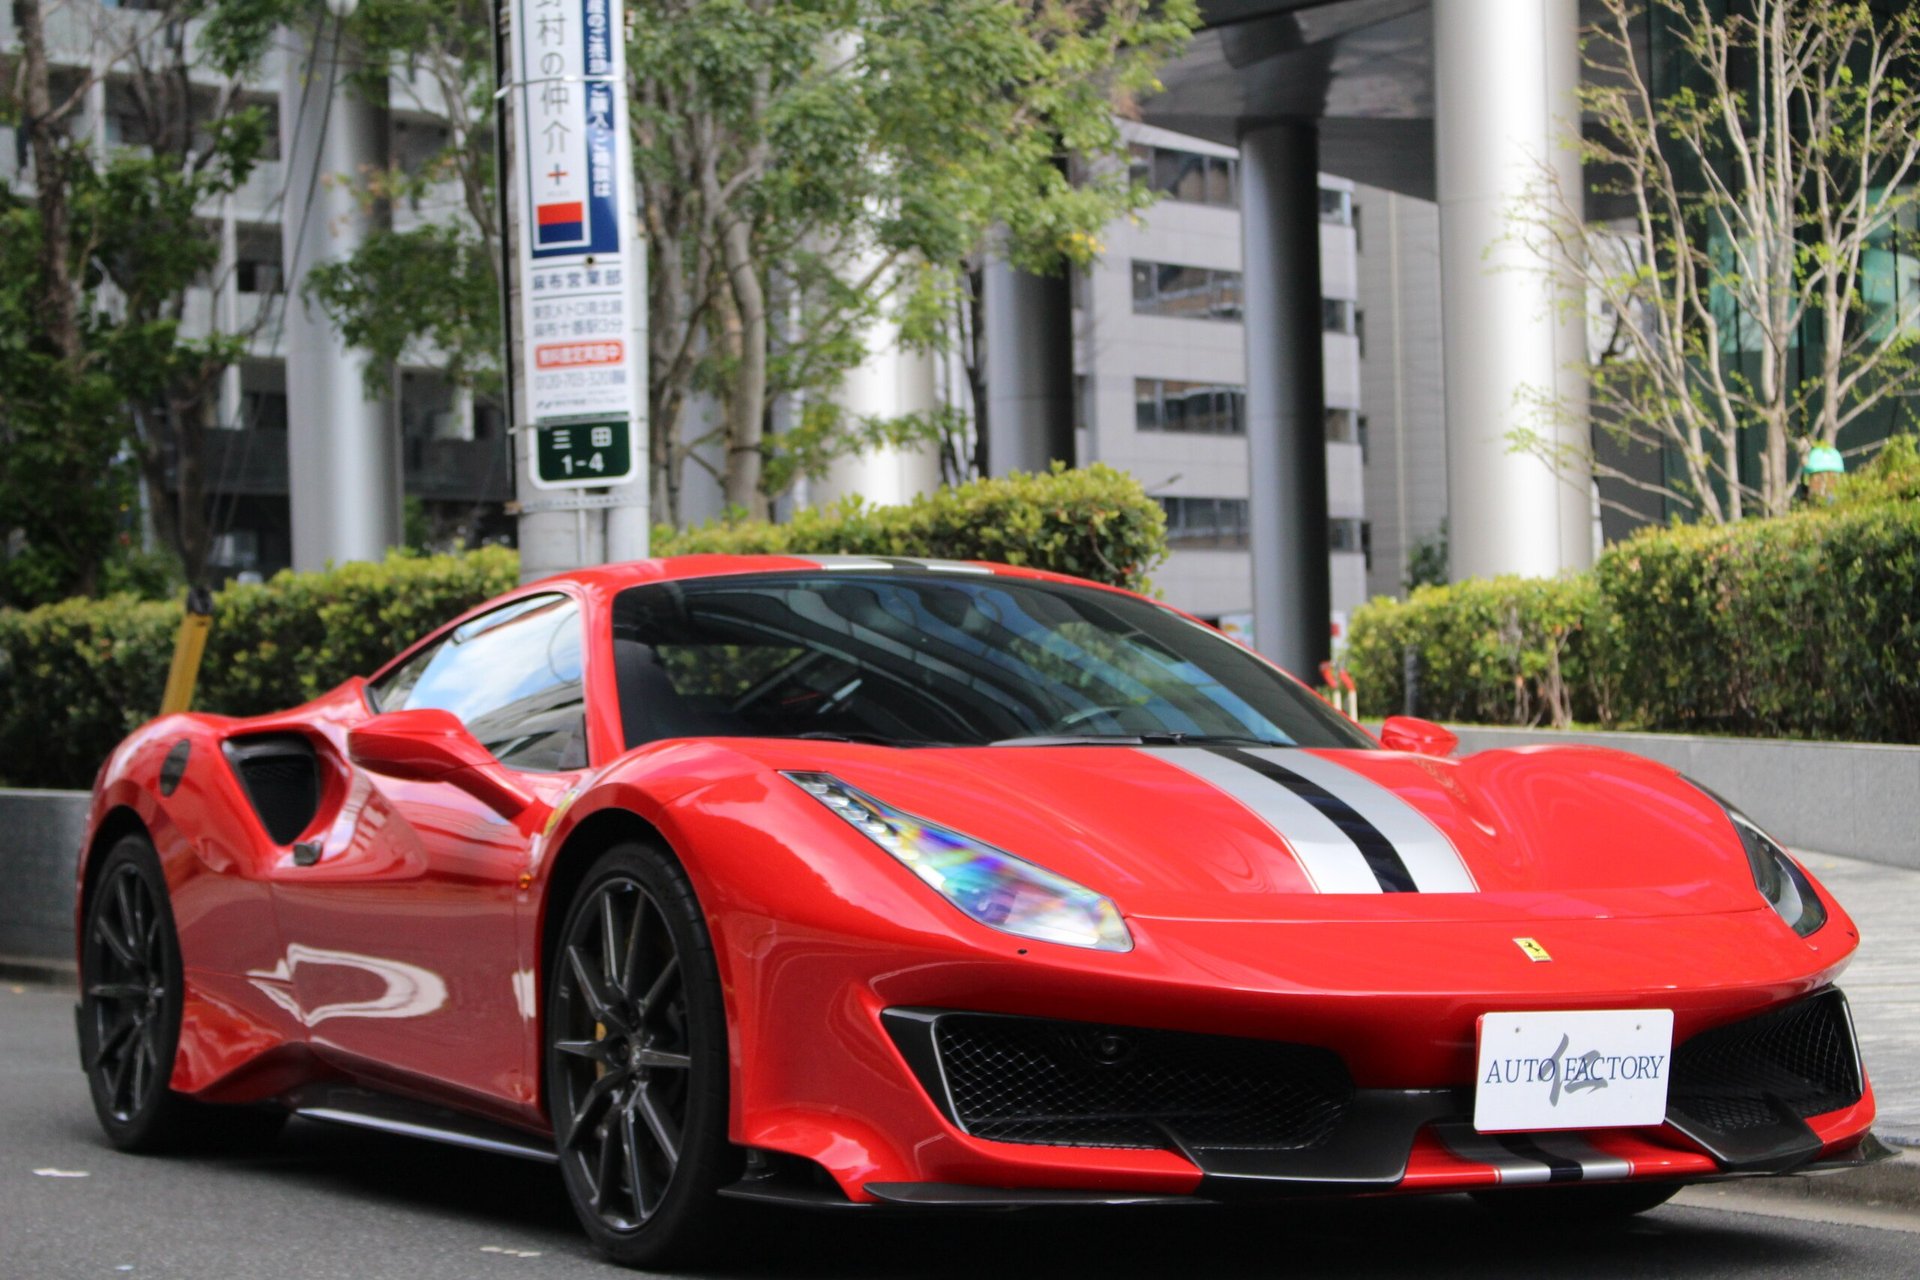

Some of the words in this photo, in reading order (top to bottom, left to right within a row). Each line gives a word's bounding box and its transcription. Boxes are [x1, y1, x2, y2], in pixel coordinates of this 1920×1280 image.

[561, 452, 605, 475] 1-4
[1485, 1058, 1556, 1084] AUTO
[1563, 1055, 1666, 1082] FACTORY
